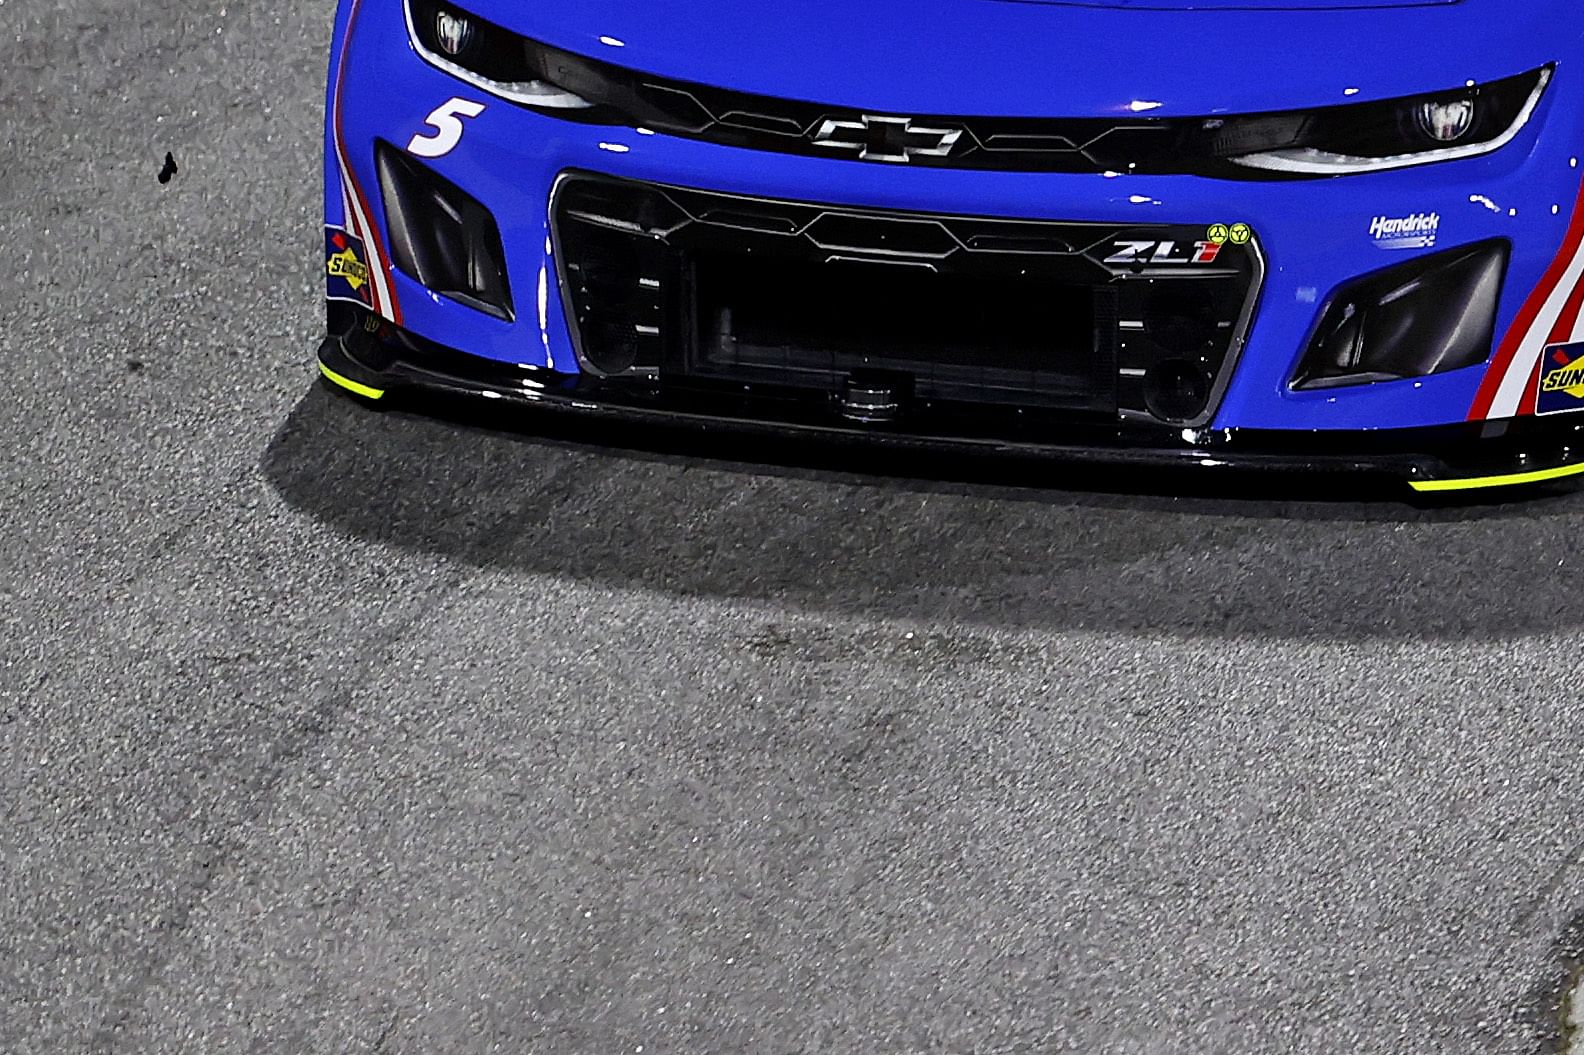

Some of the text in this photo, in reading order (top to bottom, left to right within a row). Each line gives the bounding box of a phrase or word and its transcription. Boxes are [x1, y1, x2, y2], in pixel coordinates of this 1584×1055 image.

[407, 96, 487, 158] 5
[1369, 212, 1440, 239] Hendrick
[1103, 241, 1222, 263] ZL1
